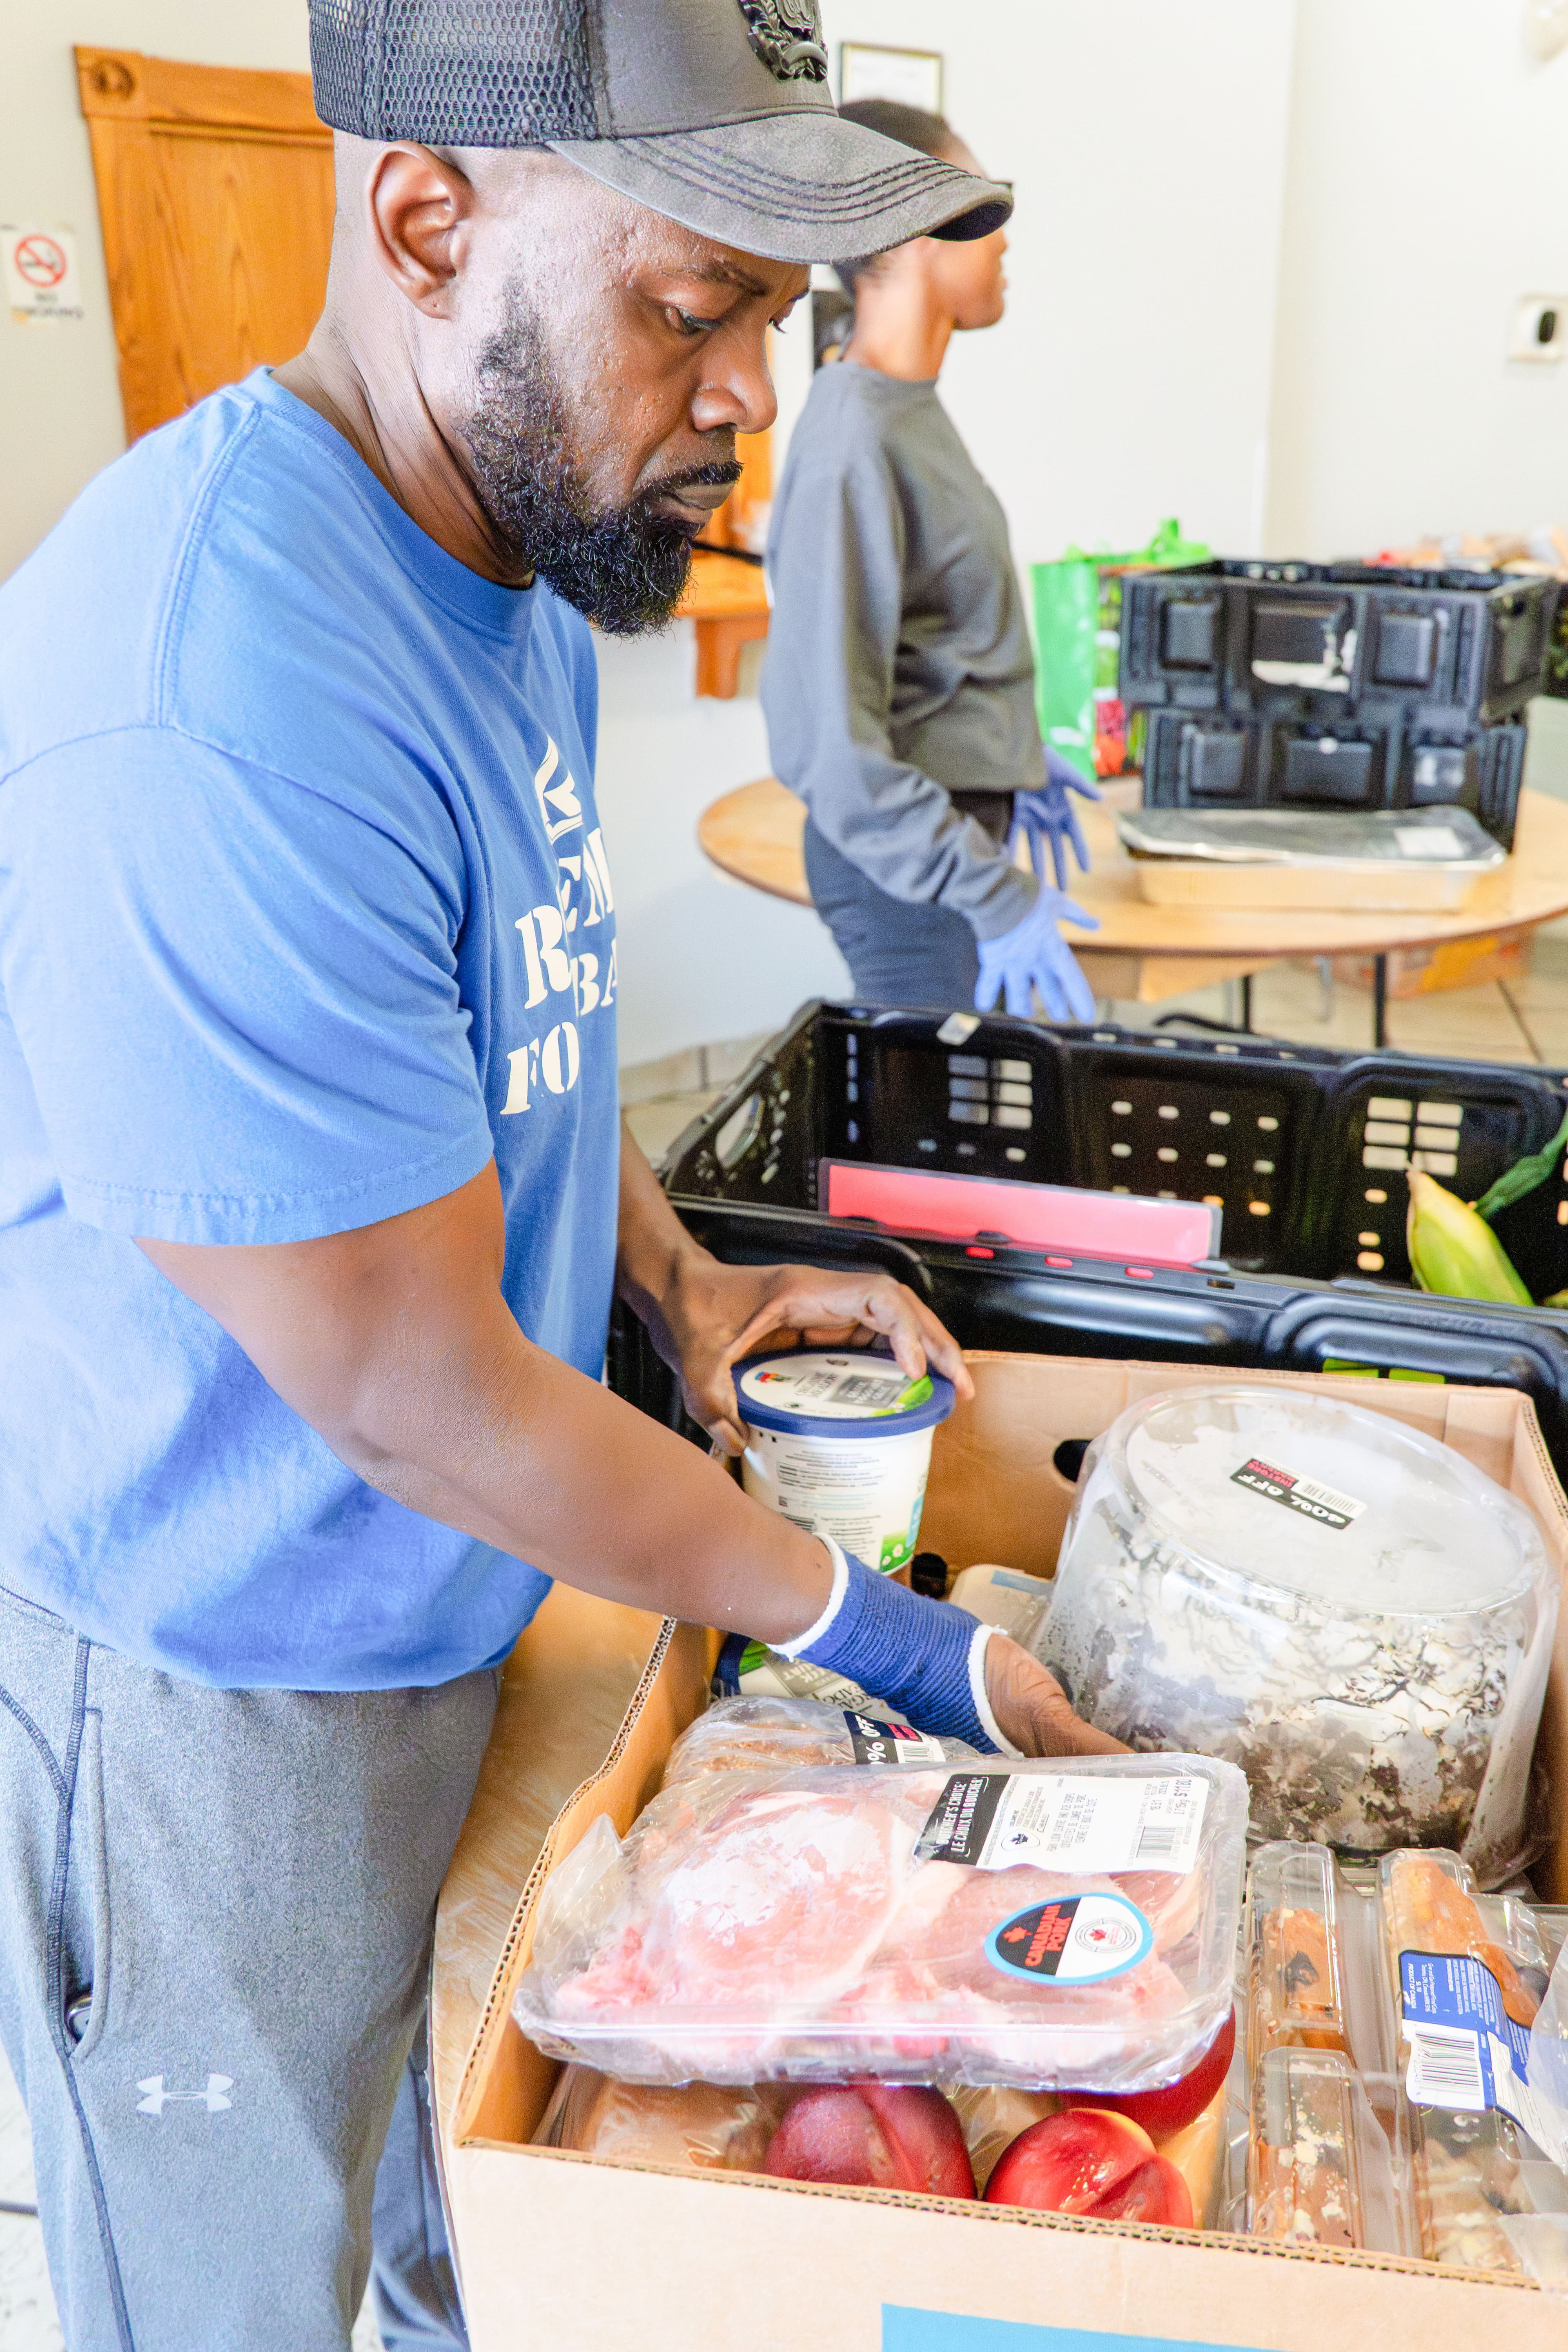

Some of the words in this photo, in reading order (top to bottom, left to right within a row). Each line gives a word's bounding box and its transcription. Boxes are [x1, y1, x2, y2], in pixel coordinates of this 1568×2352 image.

[1237, 1474, 1284, 1496] OFF
[855, 1715, 881, 1737] OFF
[962, 1779, 984, 1808] BOUCHER
[935, 1806, 959, 1845] BUTCHER'S
[948, 1783, 967, 1806] CHOICE
[959, 1808, 975, 1818] DU
[954, 1818, 972, 1841] CHOIX
[950, 1840, 965, 1853] LE
[1025, 1904, 1061, 1966] CANADIAN
[1045, 1916, 1072, 1951] PORK
